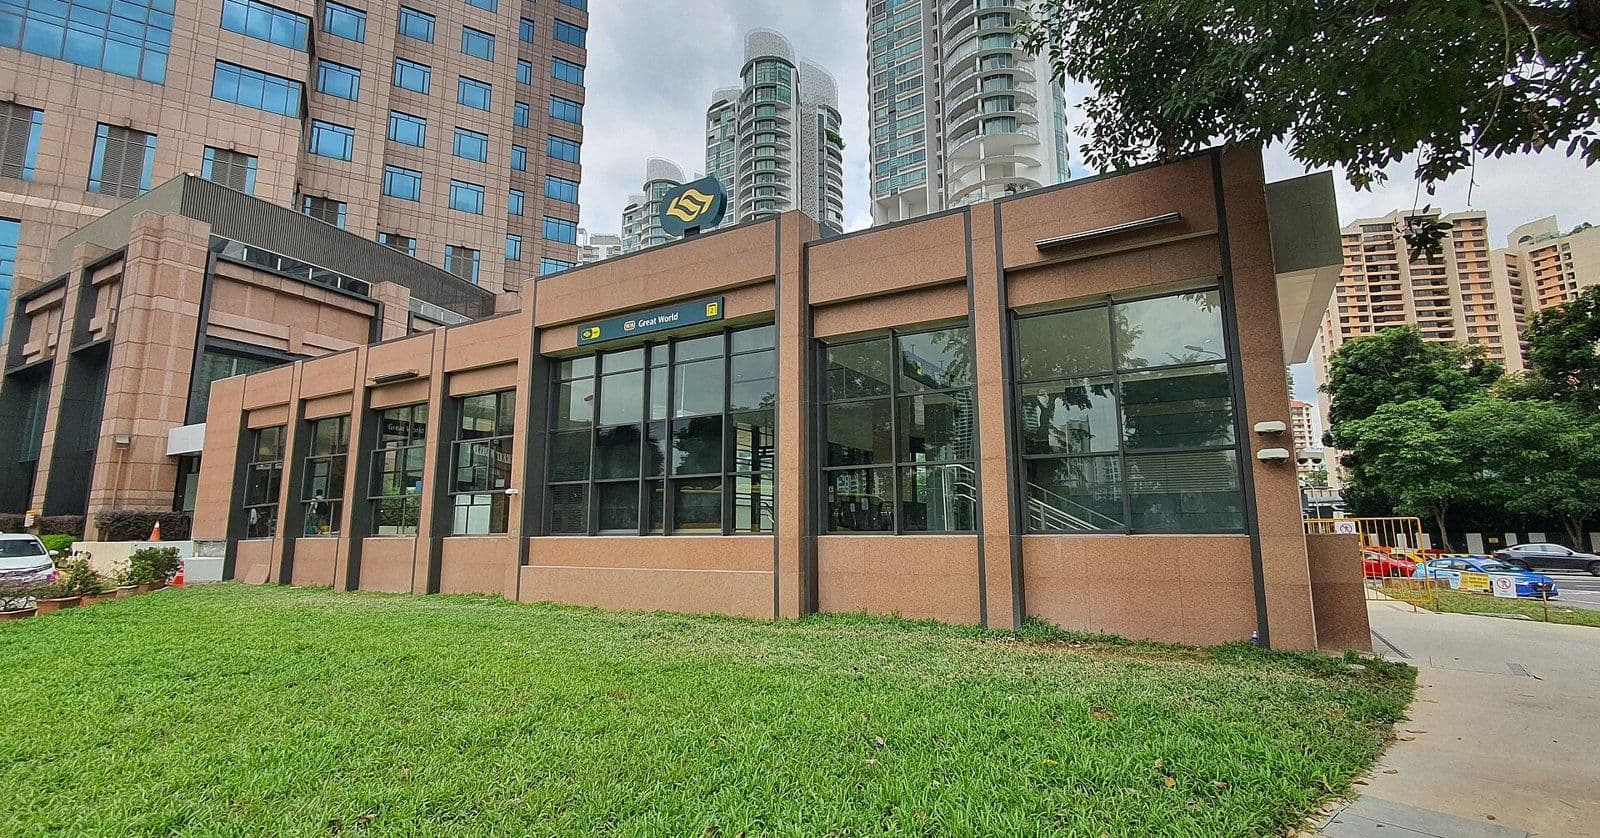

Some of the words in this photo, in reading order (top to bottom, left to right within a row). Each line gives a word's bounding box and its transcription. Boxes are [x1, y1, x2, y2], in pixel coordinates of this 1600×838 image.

[638, 318, 657, 328] Great
[658, 312, 679, 323] World
[387, 423, 405, 431] Great
